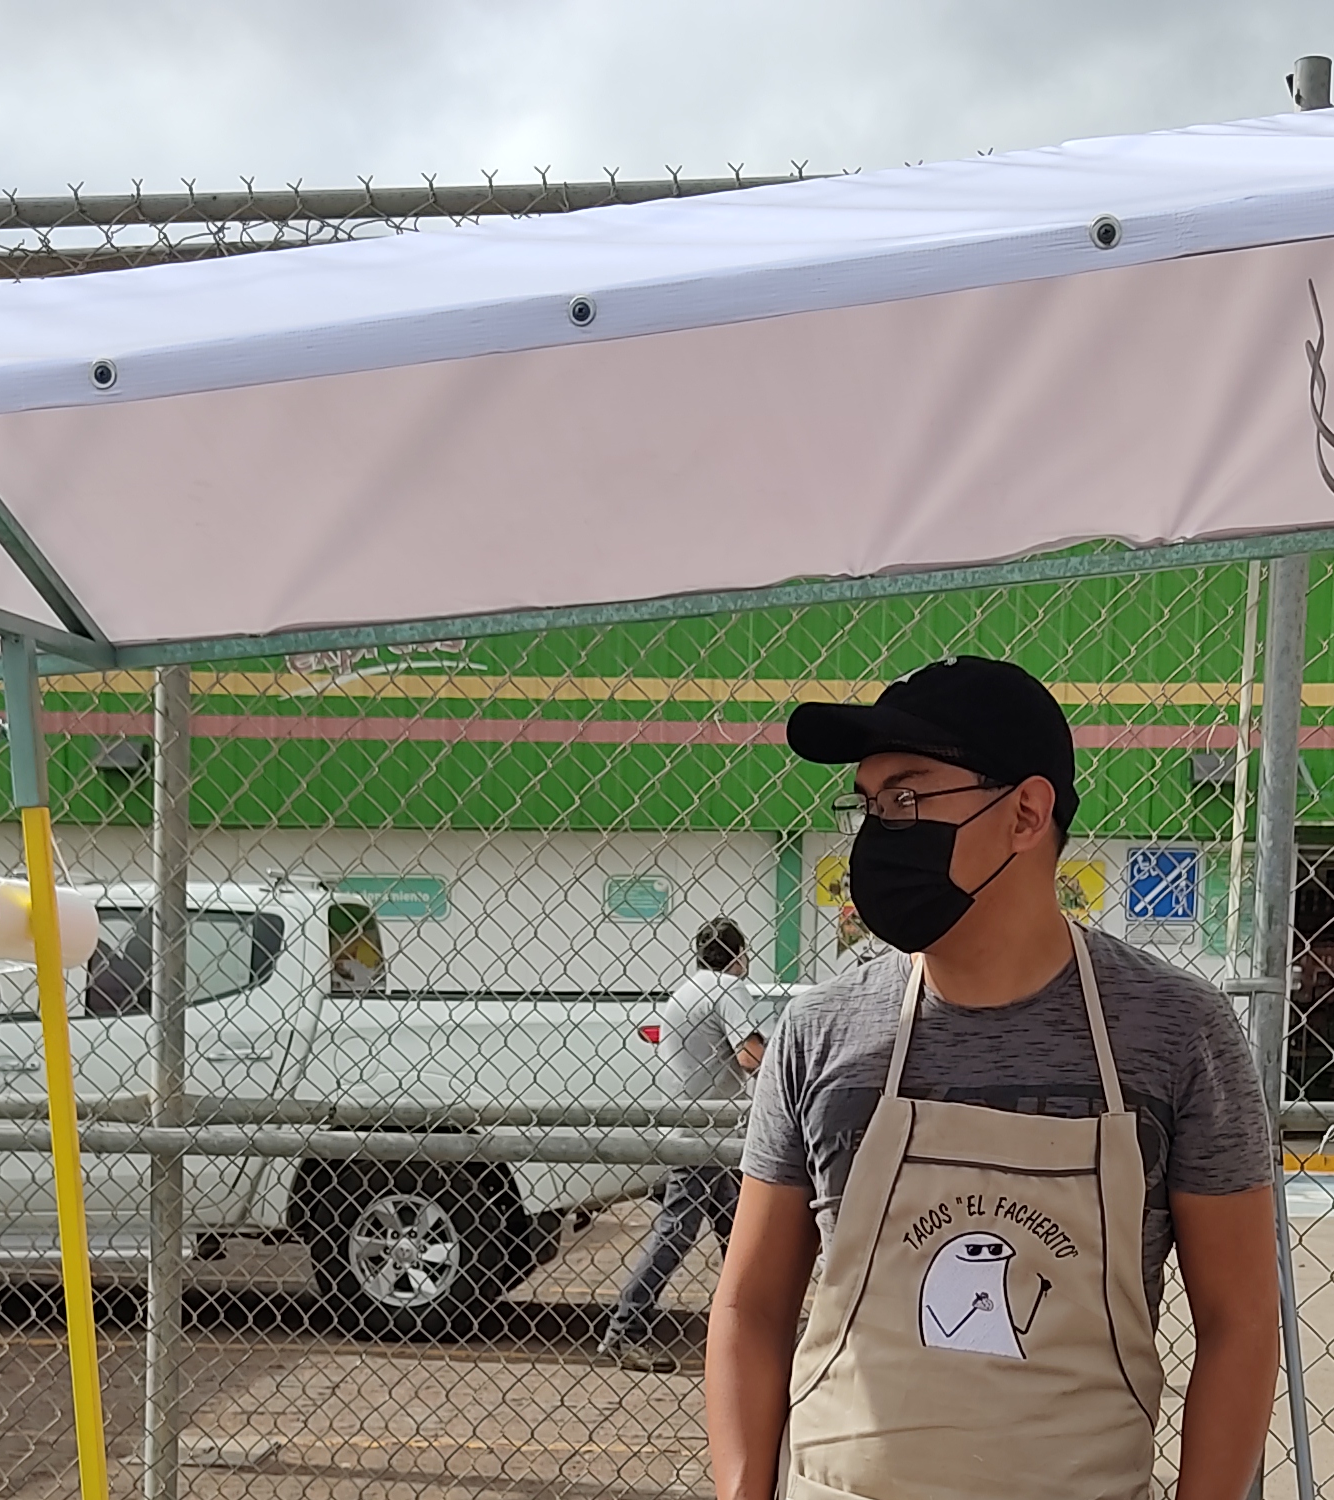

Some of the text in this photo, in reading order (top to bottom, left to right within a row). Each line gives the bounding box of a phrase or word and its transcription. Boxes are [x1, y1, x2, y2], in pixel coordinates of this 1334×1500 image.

[902, 1194, 1081, 1260] TACOS "EL FACHERITO"
